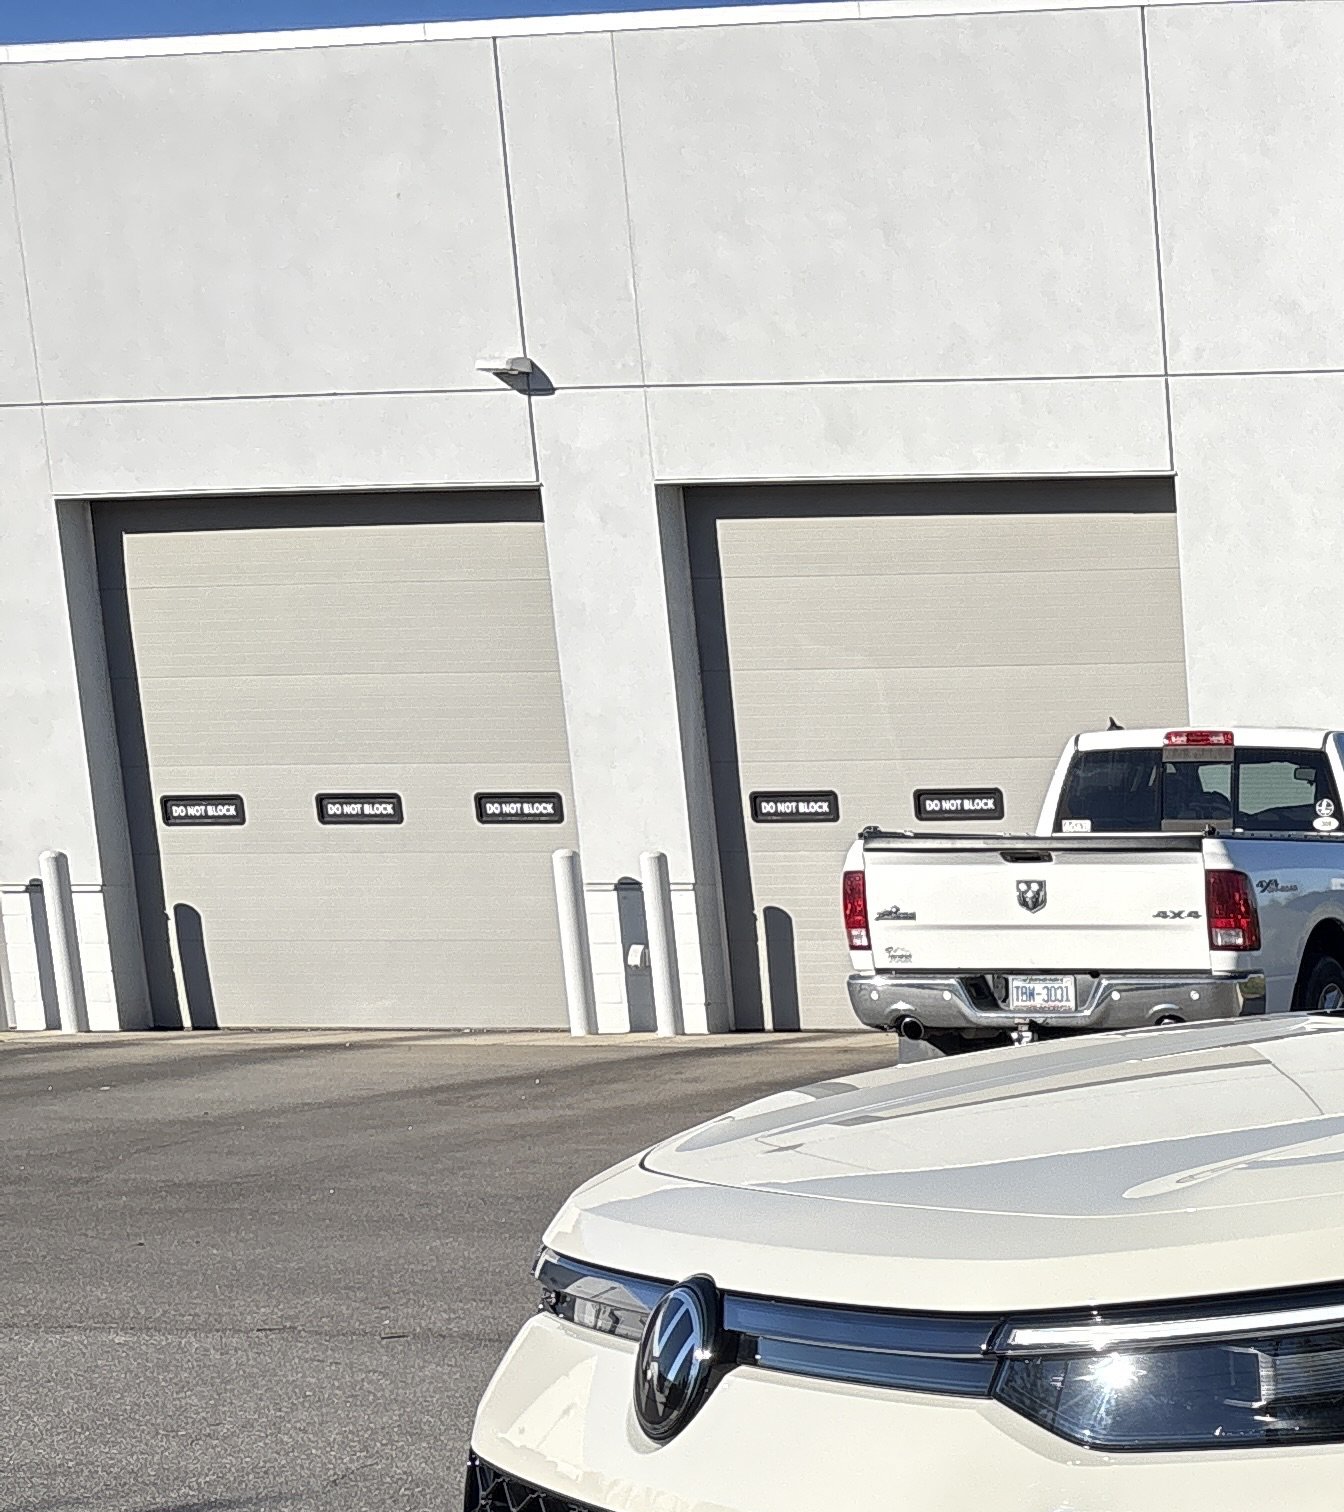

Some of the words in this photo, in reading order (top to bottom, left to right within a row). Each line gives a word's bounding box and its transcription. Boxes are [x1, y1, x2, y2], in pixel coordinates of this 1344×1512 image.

[327, 804, 342, 815] DO
[342, 804, 362, 815] NOT
[363, 804, 394, 815] BLOCK
[486, 803, 501, 814] DO
[502, 803, 521, 814] NOT
[522, 803, 554, 814] BLOCK
[761, 802, 776, 813] DO
[777, 802, 797, 813] NOT
[798, 802, 829, 813] BLOCK
[926, 800, 940, 811] DO
[941, 800, 962, 811] NOT
[963, 798, 995, 810] BLOCK
[171, 805, 186, 817] DO
[186, 805, 206, 817] NOT
[207, 804, 237, 816] BLOCK
